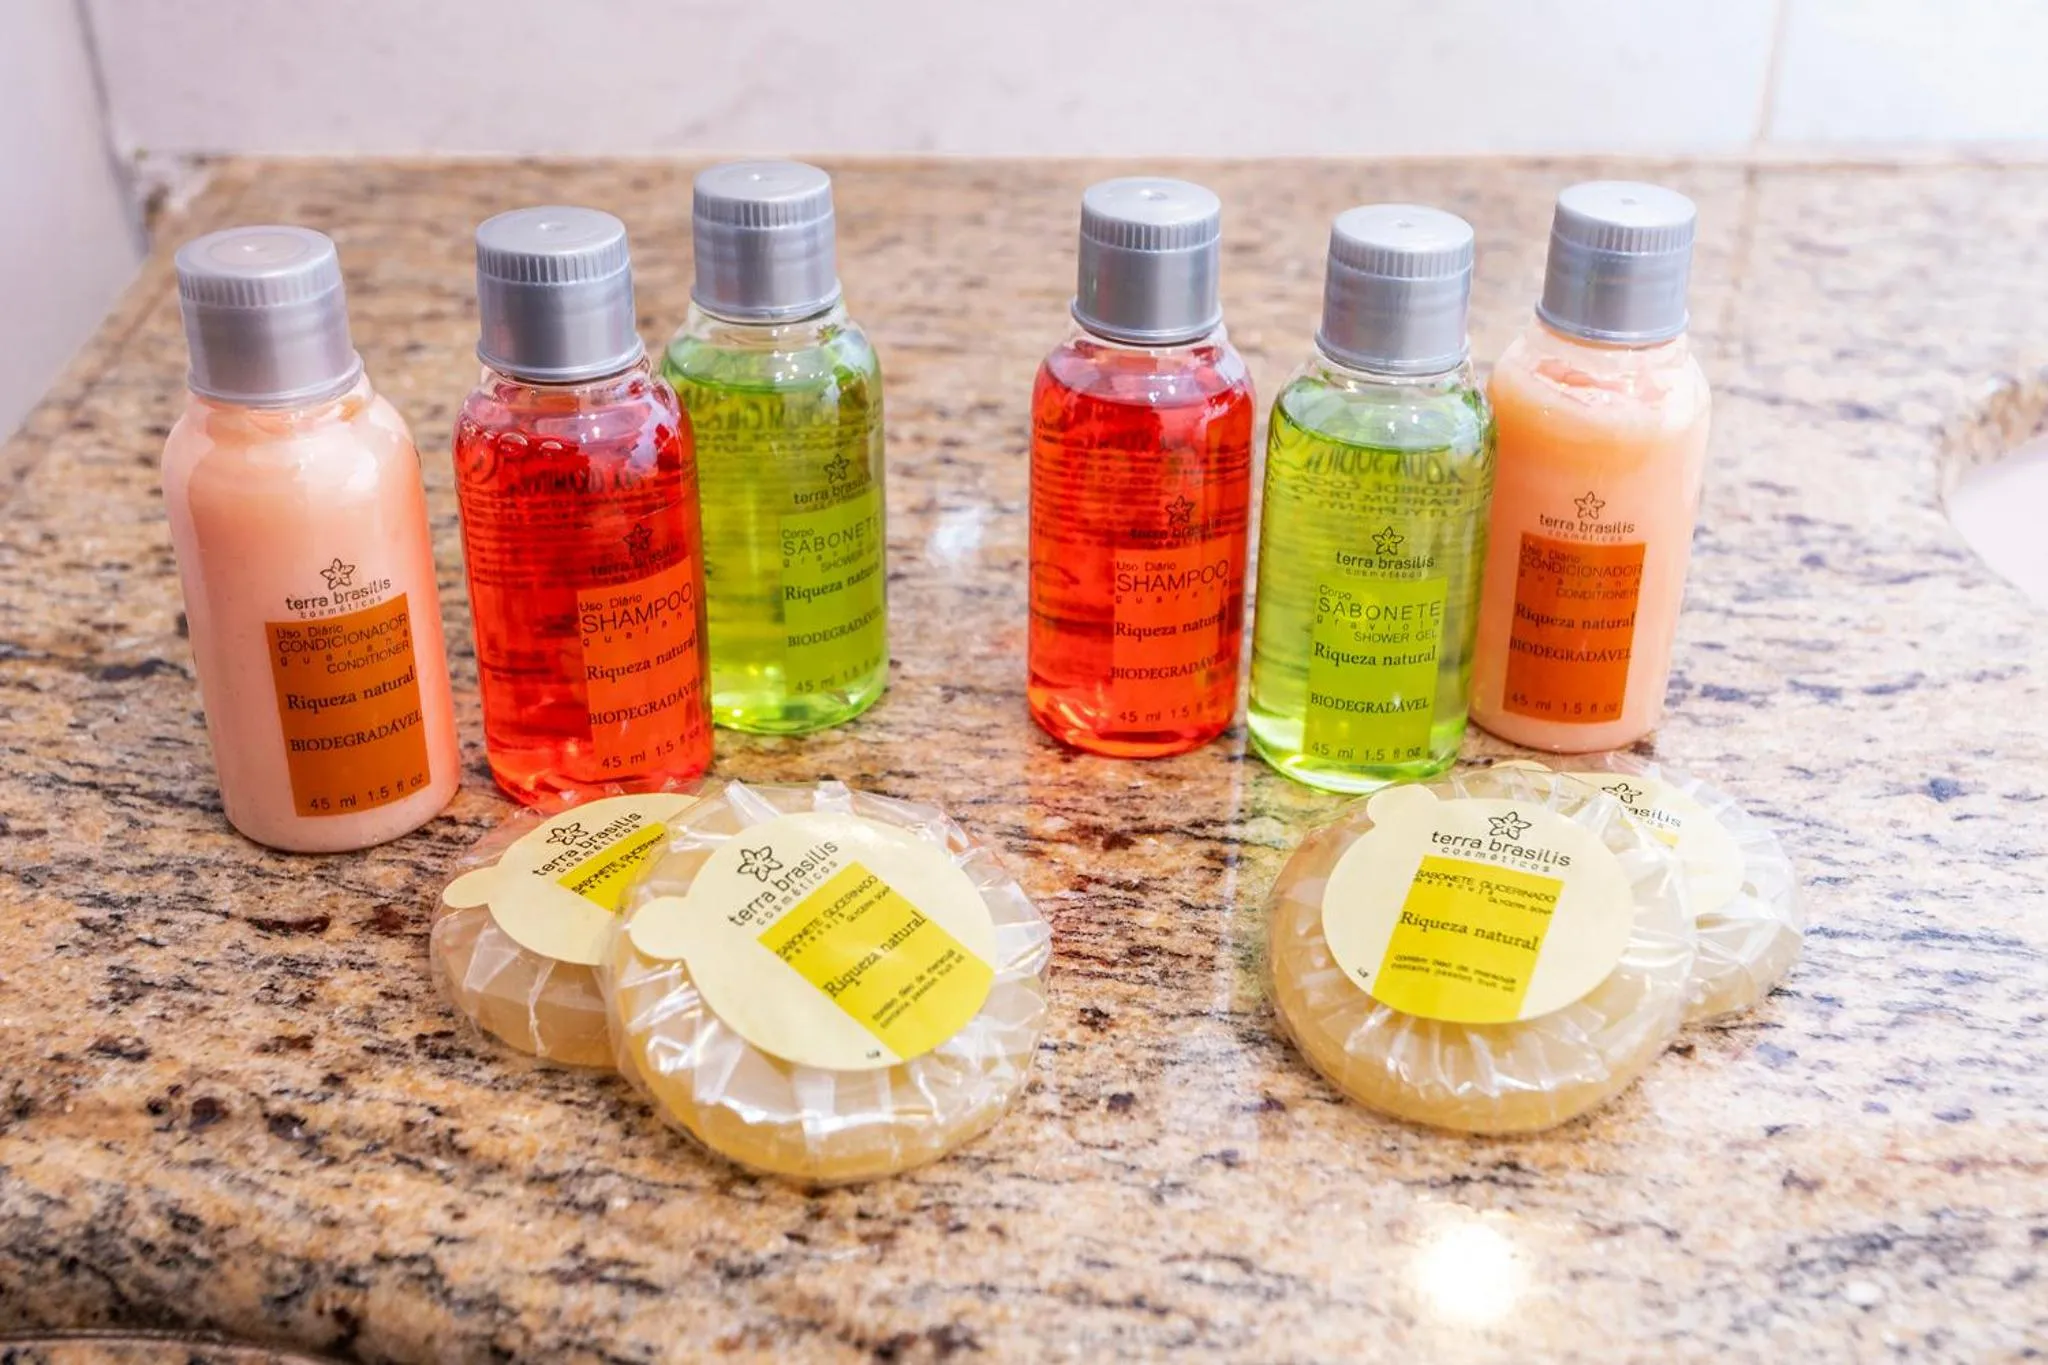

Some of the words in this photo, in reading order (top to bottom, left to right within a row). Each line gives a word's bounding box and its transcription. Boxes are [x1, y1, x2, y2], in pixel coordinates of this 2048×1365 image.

[782, 528, 815, 540] Corpo
[1539, 513, 1575, 531] terra
[1579, 520, 1635, 534] brasilis
[1116, 561, 1138, 572] Uso
[1336, 550, 1373, 568] terra
[1378, 556, 1435, 570] brasilis
[1117, 560, 1228, 592] SHAMPOO
[285, 596, 328, 611] terra
[333, 578, 392, 606] brasilis
[580, 602, 603, 612] Uso
[610, 594, 642, 610] Diário
[785, 581, 843, 604] Riqueza
[1320, 584, 1352, 600] Corpo
[582, 582, 692, 634] SHAMPOO
[1318, 597, 1441, 621] SABONETE
[1516, 602, 1574, 628] Riqueza
[1582, 610, 1636, 630] natural
[276, 628, 300, 640] Uso
[308, 624, 344, 638] Diário
[278, 613, 408, 654] CONDICIONADOR
[1115, 622, 1177, 642] Riqueza
[1354, 631, 1410, 644] SHOWER
[1415, 629, 1437, 642] GEL
[326, 640, 409, 674] CONDITIONER
[586, 660, 652, 683] Riqueza
[656, 628, 696, 666] natural
[1314, 642, 1377, 668] Riqueza
[1382, 644, 1436, 666] natural
[1510, 636, 1631, 662] BIODEGRADÁVEL
[286, 692, 357, 714] Riqueza
[362, 664, 414, 700] natural
[795, 680, 814, 692] 45
[1311, 691, 1430, 714] BIODEGRADÁVEL
[1562, 702, 1582, 714] 1.5
[1119, 710, 1138, 723] 45
[1145, 711, 1162, 722] ml
[290, 710, 423, 752] BIODEGRADÁVEL
[602, 755, 622, 769] 45
[630, 750, 646, 765] ml
[656, 740, 674, 757] 1.5
[1312, 742, 1330, 756] 45
[1337, 748, 1354, 759] ml
[1366, 748, 1384, 761] 1.5
[310, 797, 330, 810] 45
[339, 795, 357, 810] ml
[368, 786, 389, 802] 1.5
[532, 848, 578, 876] terra
[576, 812, 642, 849] brasilis
[557, 823, 640, 873] cosméticos
[1431, 830, 1482, 849] terra
[1488, 838, 1572, 867] brasilis
[1442, 846, 1550, 872] cosméticos
[572, 860, 618, 894] SABONETE
[728, 891, 776, 926] terra
[770, 841, 838, 892] brasilis
[1416, 870, 1474, 886] SABONETE
[1479, 880, 1557, 904] GLICERINADO
[756, 860, 838, 926] cosméticos
[776, 917, 824, 959] SABONETE
[1400, 910, 1468, 934] Riqueza
[1474, 927, 1540, 952] natural
[824, 952, 882, 998] Riqueza
[880, 909, 928, 953] natural
